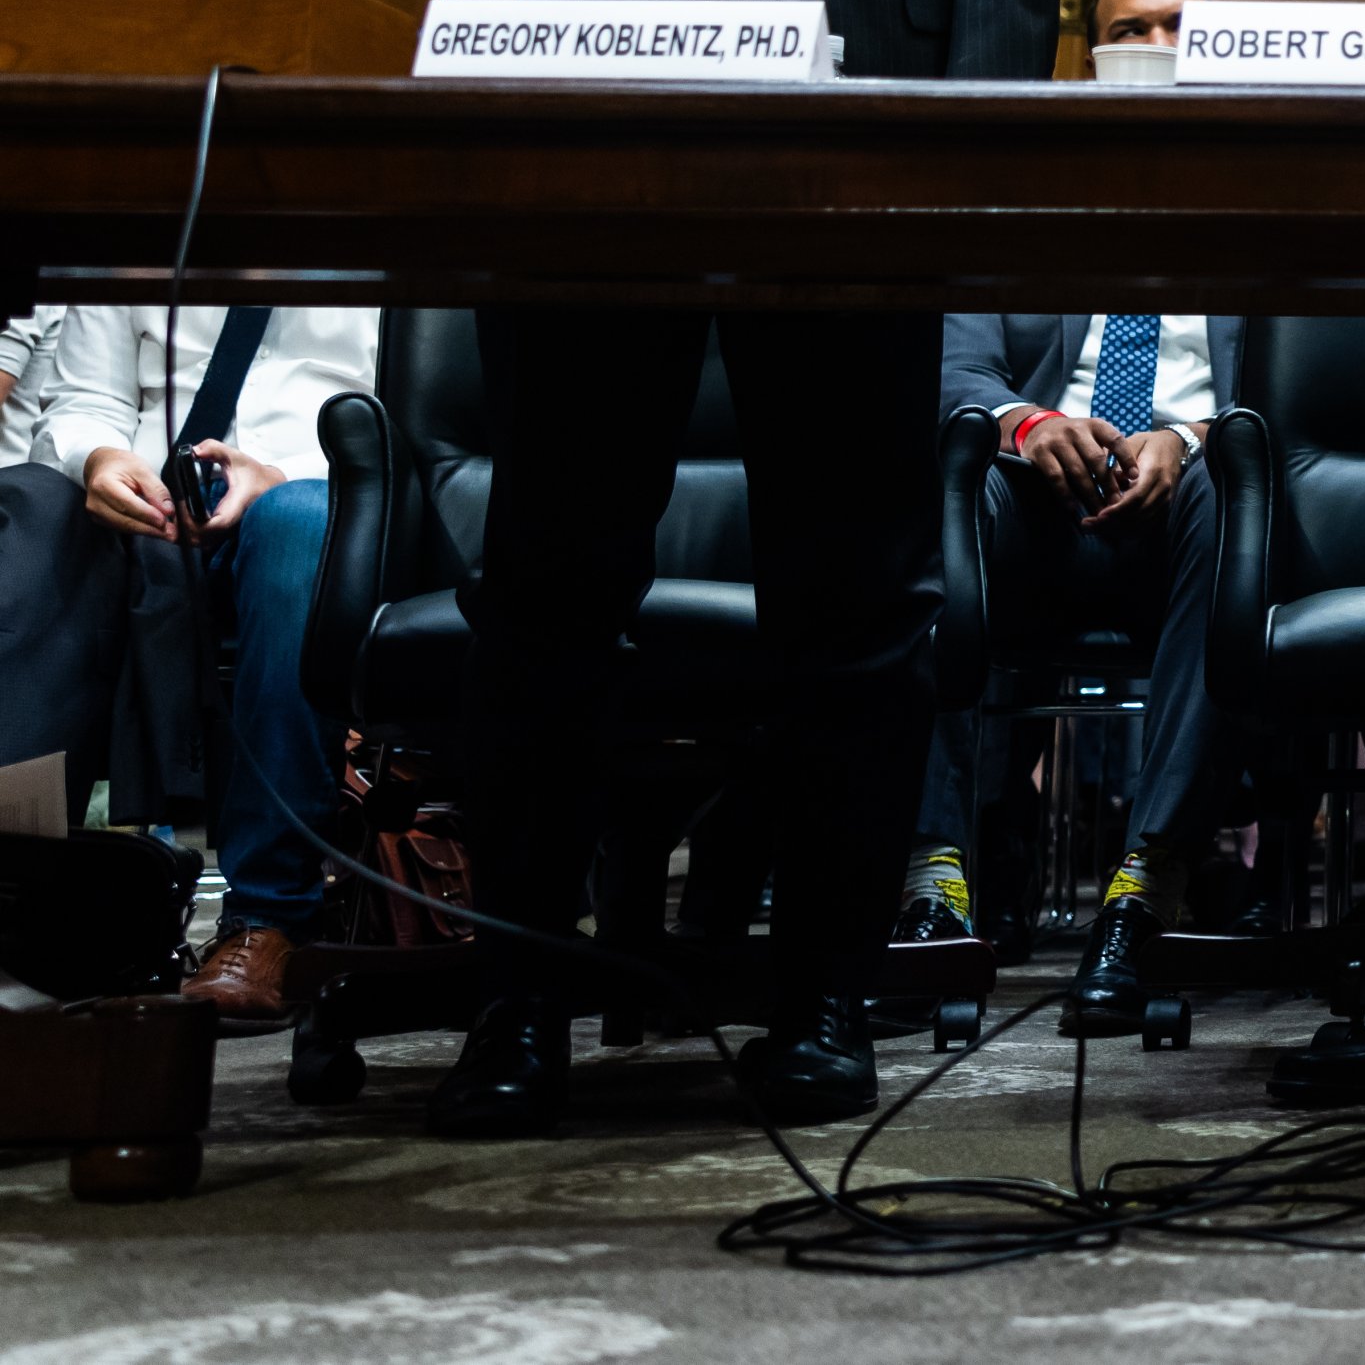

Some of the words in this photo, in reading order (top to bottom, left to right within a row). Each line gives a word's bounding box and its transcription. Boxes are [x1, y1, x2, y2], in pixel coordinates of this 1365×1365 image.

[432, 23, 570, 56] GREGORY
[575, 24, 724, 62] KOBLENTZ,
[735, 25, 805, 58] PH.D.
[1187, 29, 1330, 59] ROBERT
